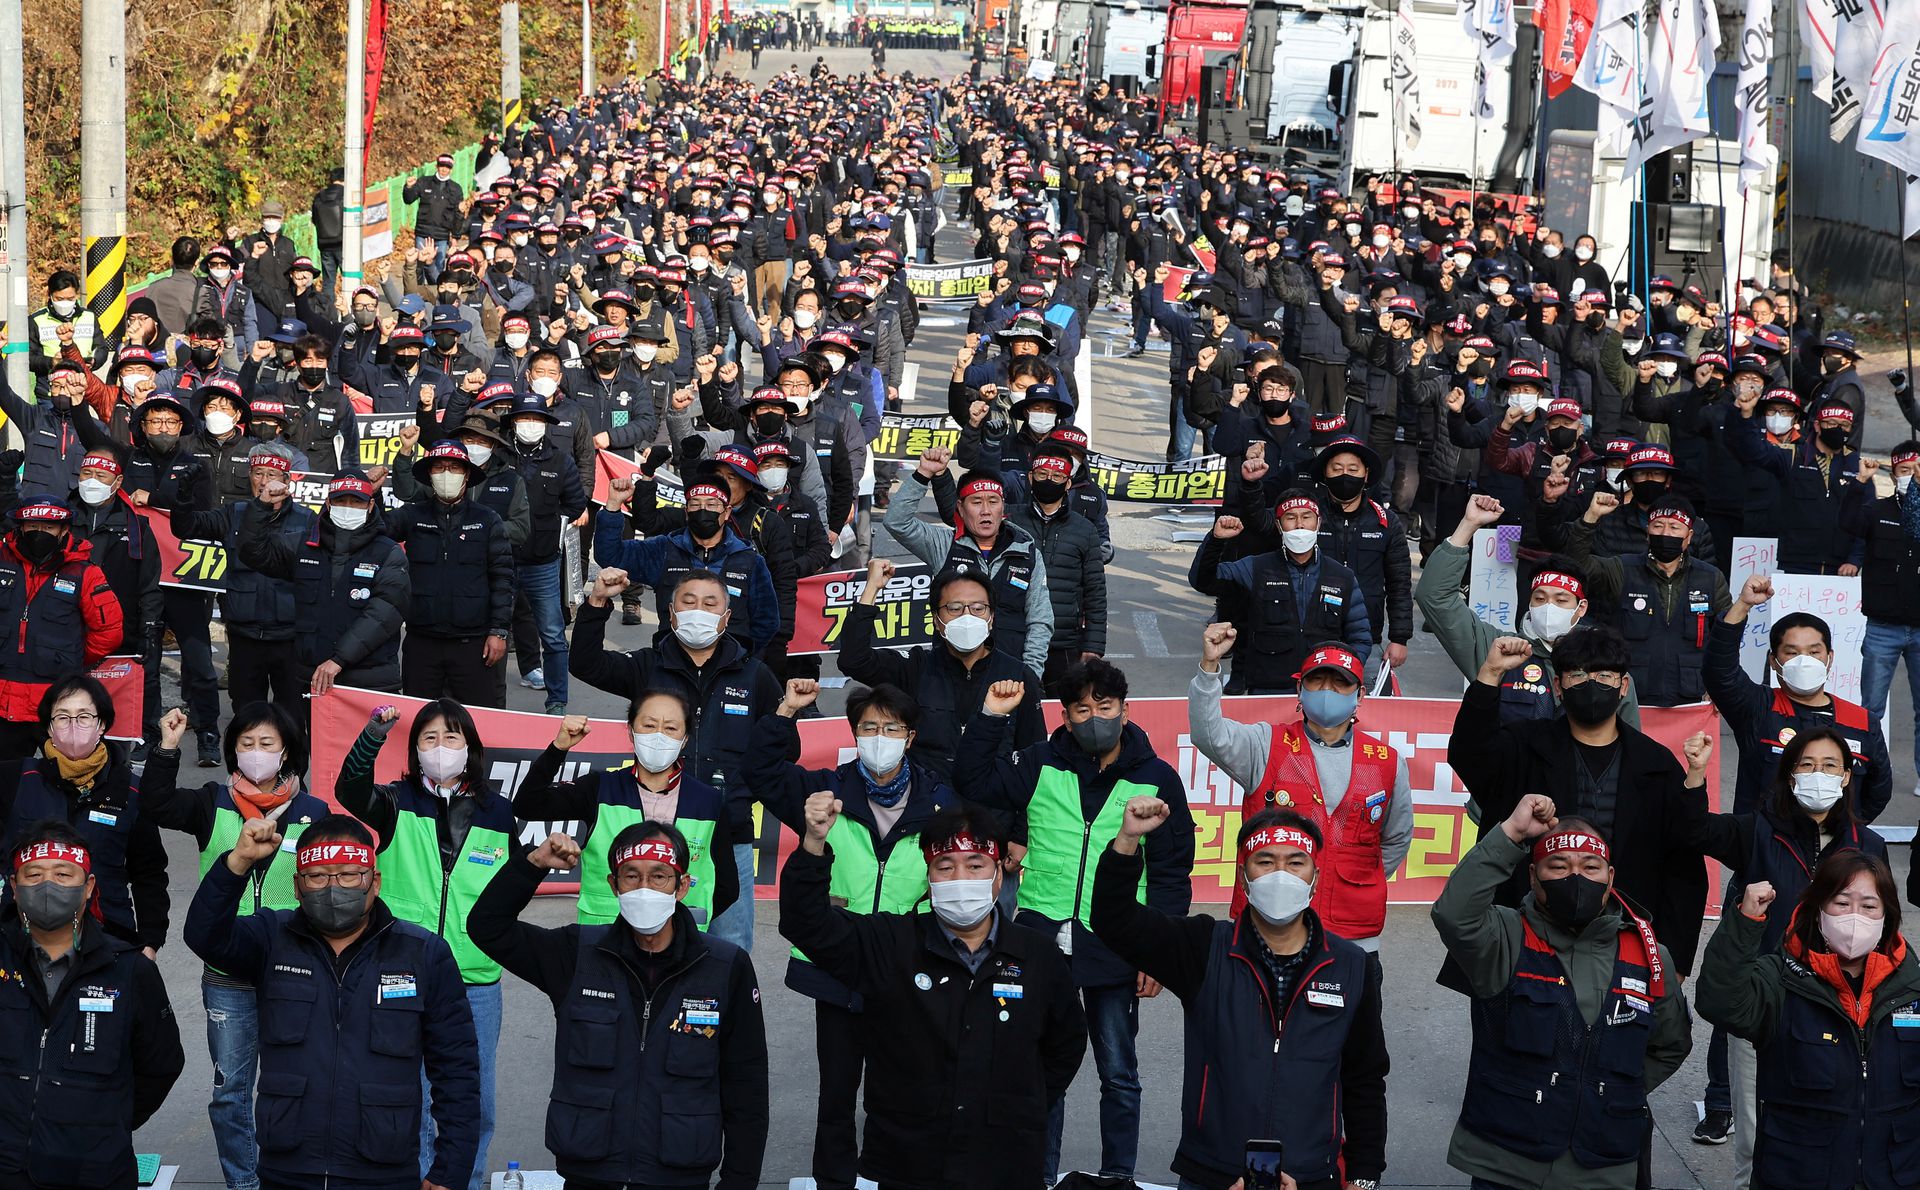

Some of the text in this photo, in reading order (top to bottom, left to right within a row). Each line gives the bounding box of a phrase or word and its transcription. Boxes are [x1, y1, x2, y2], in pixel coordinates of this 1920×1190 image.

[1822, 409, 1834, 417] 단결
[880, 415, 942, 430] 운임제
[905, 428, 961, 456] 총파
[1064, 431, 1078, 441] 단결
[754, 446, 767, 455] 단결
[272, 457, 287, 468] 투쟁
[732, 454, 747, 466] 투쟁
[1048, 457, 1065, 470] 투쟁
[1631, 452, 1670, 463] 단결 투쟁
[100, 459, 117, 471] 투쟁
[345, 480, 362, 491] 투쟁
[974, 482, 990, 491] 단결
[1126, 470, 1227, 499] 총파업!
[690, 486, 704, 497] 단결
[1282, 500, 1298, 510] 단결
[22, 508, 67, 520] 단결 투쟁
[1650, 509, 1663, 520] 단결
[1557, 575, 1579, 592] 투쟁
[1363, 744, 1388, 759] 투쟁
[1273, 828, 1313, 853] 총파업
[1545, 834, 1606, 857] 단결 투쟁
[20, 842, 84, 863] 단결 투쟁
[300, 845, 368, 864] 단결 투쟁
[616, 843, 677, 864] 단결 투쟁
